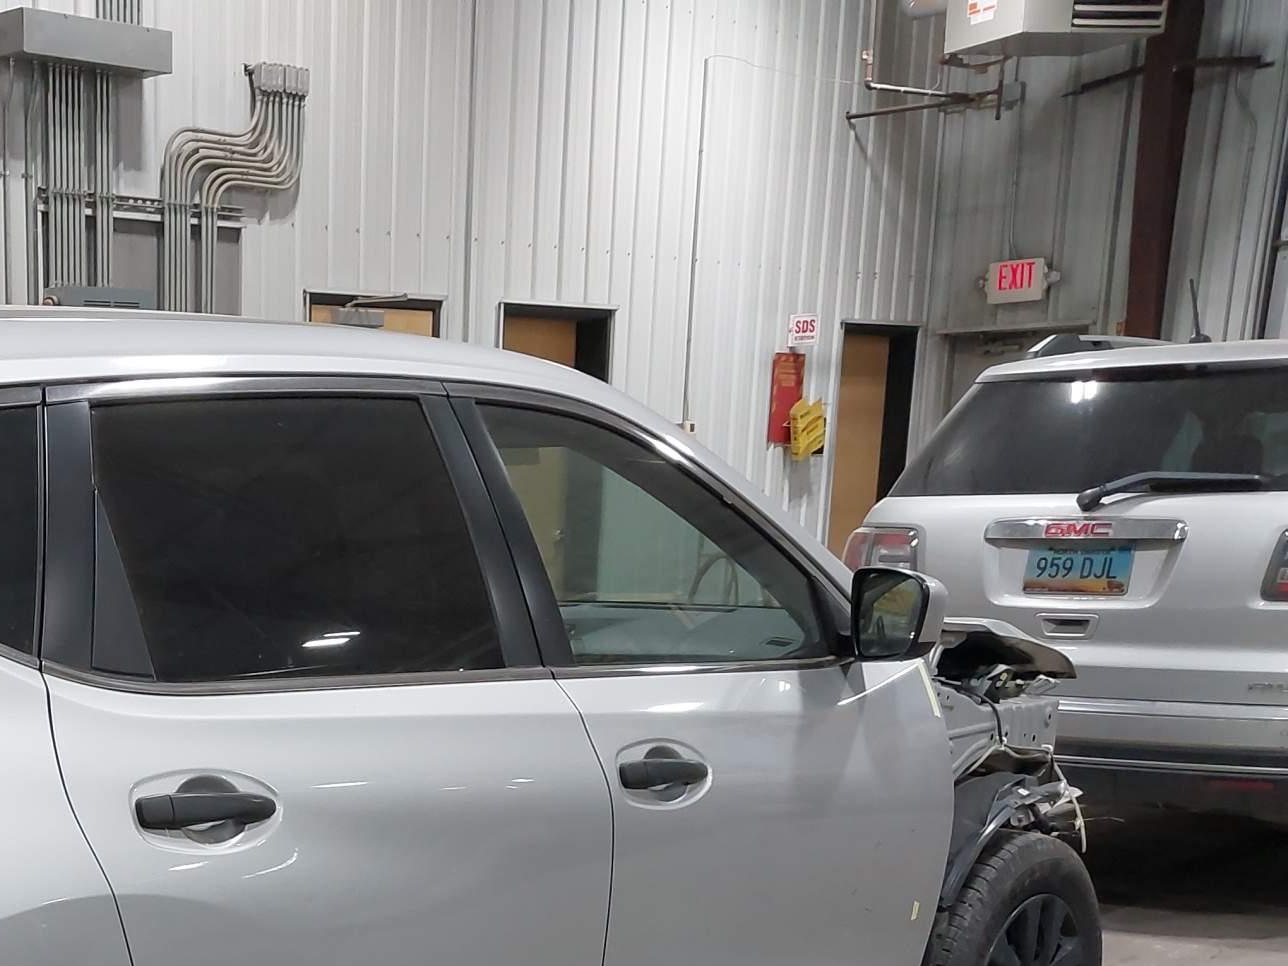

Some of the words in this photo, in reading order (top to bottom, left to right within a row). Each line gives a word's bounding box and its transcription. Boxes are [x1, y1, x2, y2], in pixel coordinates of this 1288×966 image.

[998, 262, 1035, 290] EXIT
[795, 319, 815, 334] SDS
[1044, 522, 1113, 537] GMC
[1035, 557, 1074, 578] 959
[1079, 556, 1117, 579] DJL
